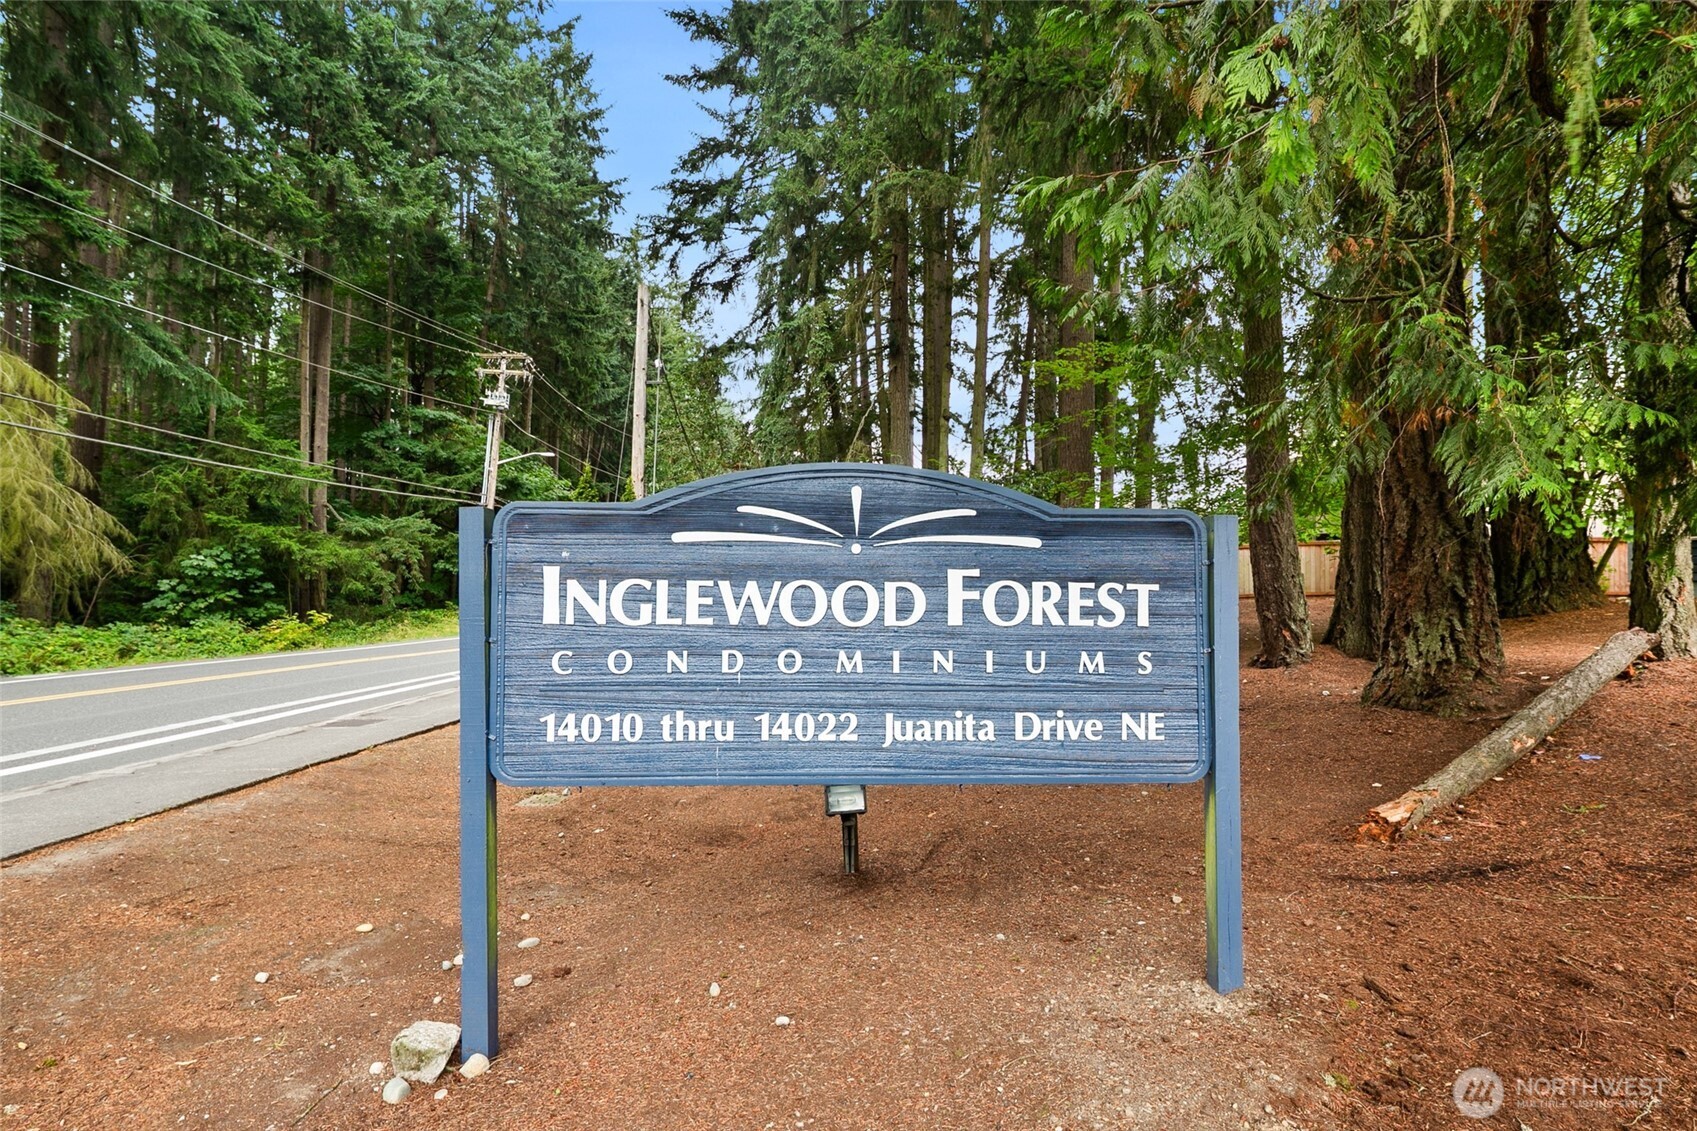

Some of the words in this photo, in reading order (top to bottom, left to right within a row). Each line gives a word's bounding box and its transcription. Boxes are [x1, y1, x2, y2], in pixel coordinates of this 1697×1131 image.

[541, 565, 927, 628] INGLEWOOD
[946, 567, 1161, 629] FOREST
[551, 649, 1153, 676] CONDOMINIUMS
[538, 711, 644, 745] 14010
[659, 709, 737, 743] thru
[753, 711, 863, 743] 14022
[881, 710, 997, 748] Juanita
[1013, 709, 1104, 742] Drive
[1120, 711, 1166, 742] NE
